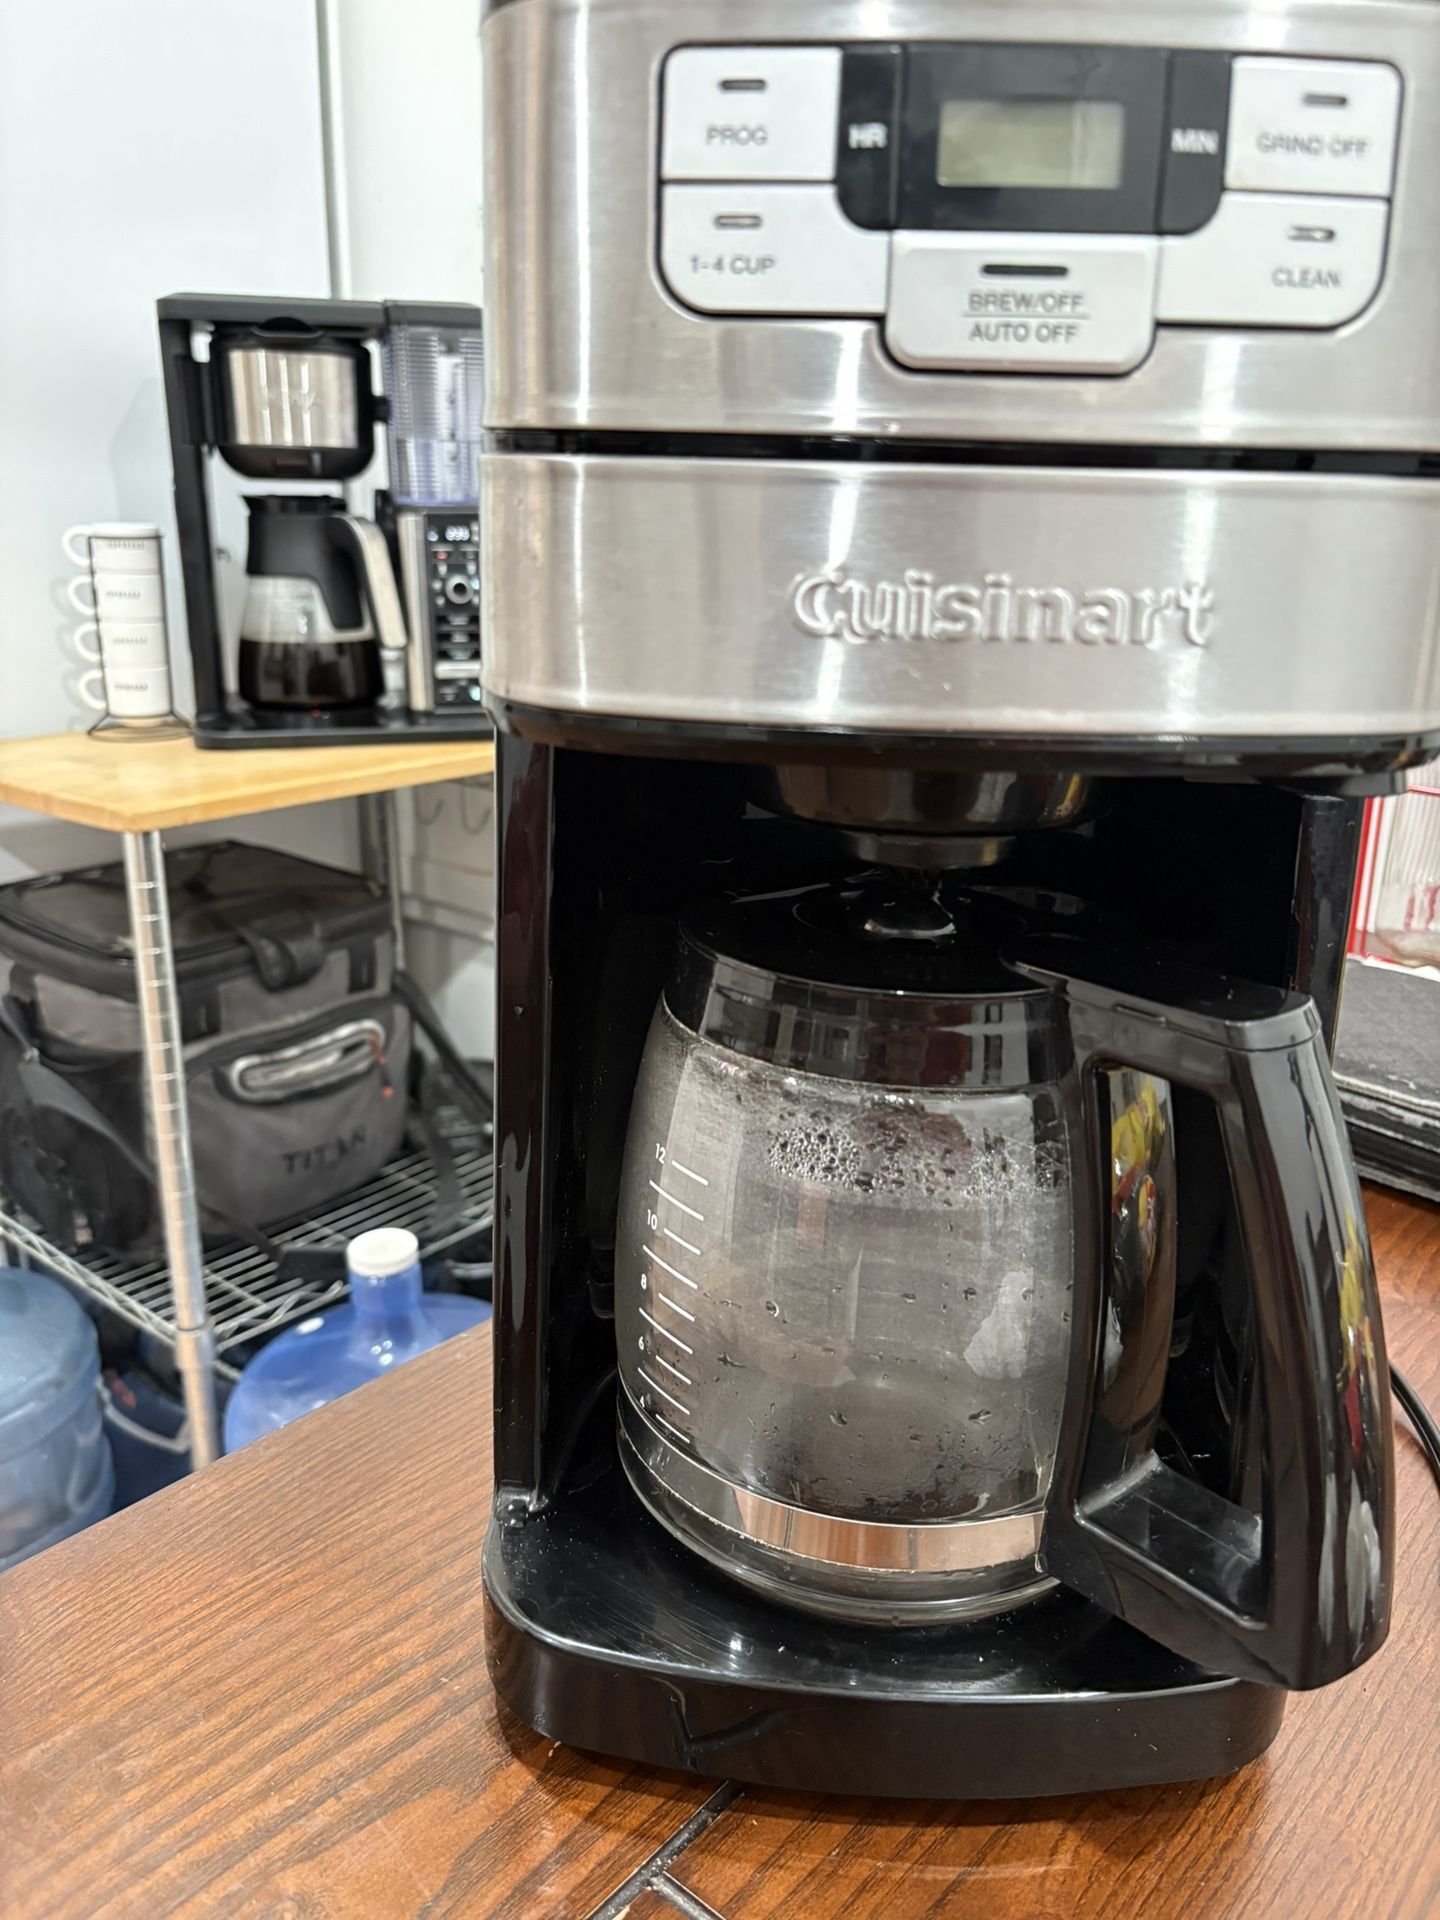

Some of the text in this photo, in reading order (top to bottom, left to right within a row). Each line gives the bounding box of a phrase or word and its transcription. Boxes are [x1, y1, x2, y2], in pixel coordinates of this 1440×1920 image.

[706, 124, 768, 145] PROG
[848, 122, 888, 149] HR
[1170, 128, 1219, 155] MIN
[1257, 132, 1368, 157] GRIND OFF
[729, 254, 776, 276] CUP
[1271, 267, 1341, 289] CLEAN
[967, 290, 1084, 313] BREW/OFF
[968, 321, 1079, 343] AUTO OFF
[793, 568, 1214, 646] Cuisinart
[283, 1126, 368, 1174] TITAN
[655, 1143, 666, 1164] 12
[647, 1209, 658, 1231] 10
[641, 1273, 648, 1290] 8
[638, 1335, 645, 1351] 6
